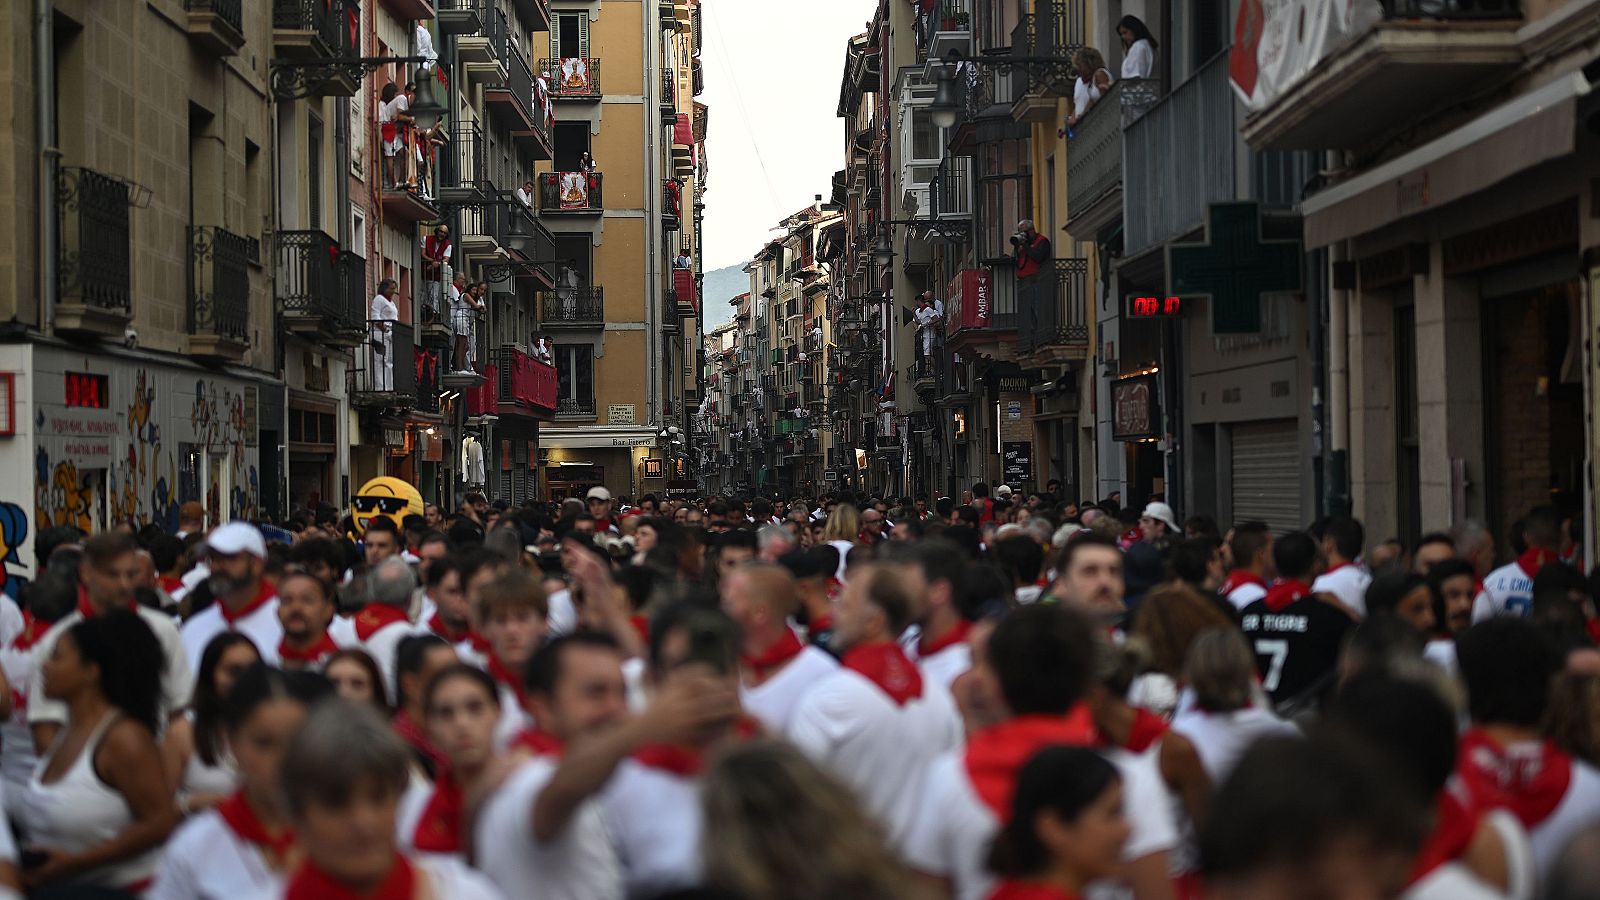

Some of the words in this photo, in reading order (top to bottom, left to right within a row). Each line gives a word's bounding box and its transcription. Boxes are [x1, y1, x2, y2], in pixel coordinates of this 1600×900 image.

[978, 286, 986, 319] AMBAR
[612, 438, 626, 446] Bar
[628, 438, 651, 446] Fitero
[1263, 613, 1309, 633] TIGRE
[1254, 639, 1289, 692] 7
